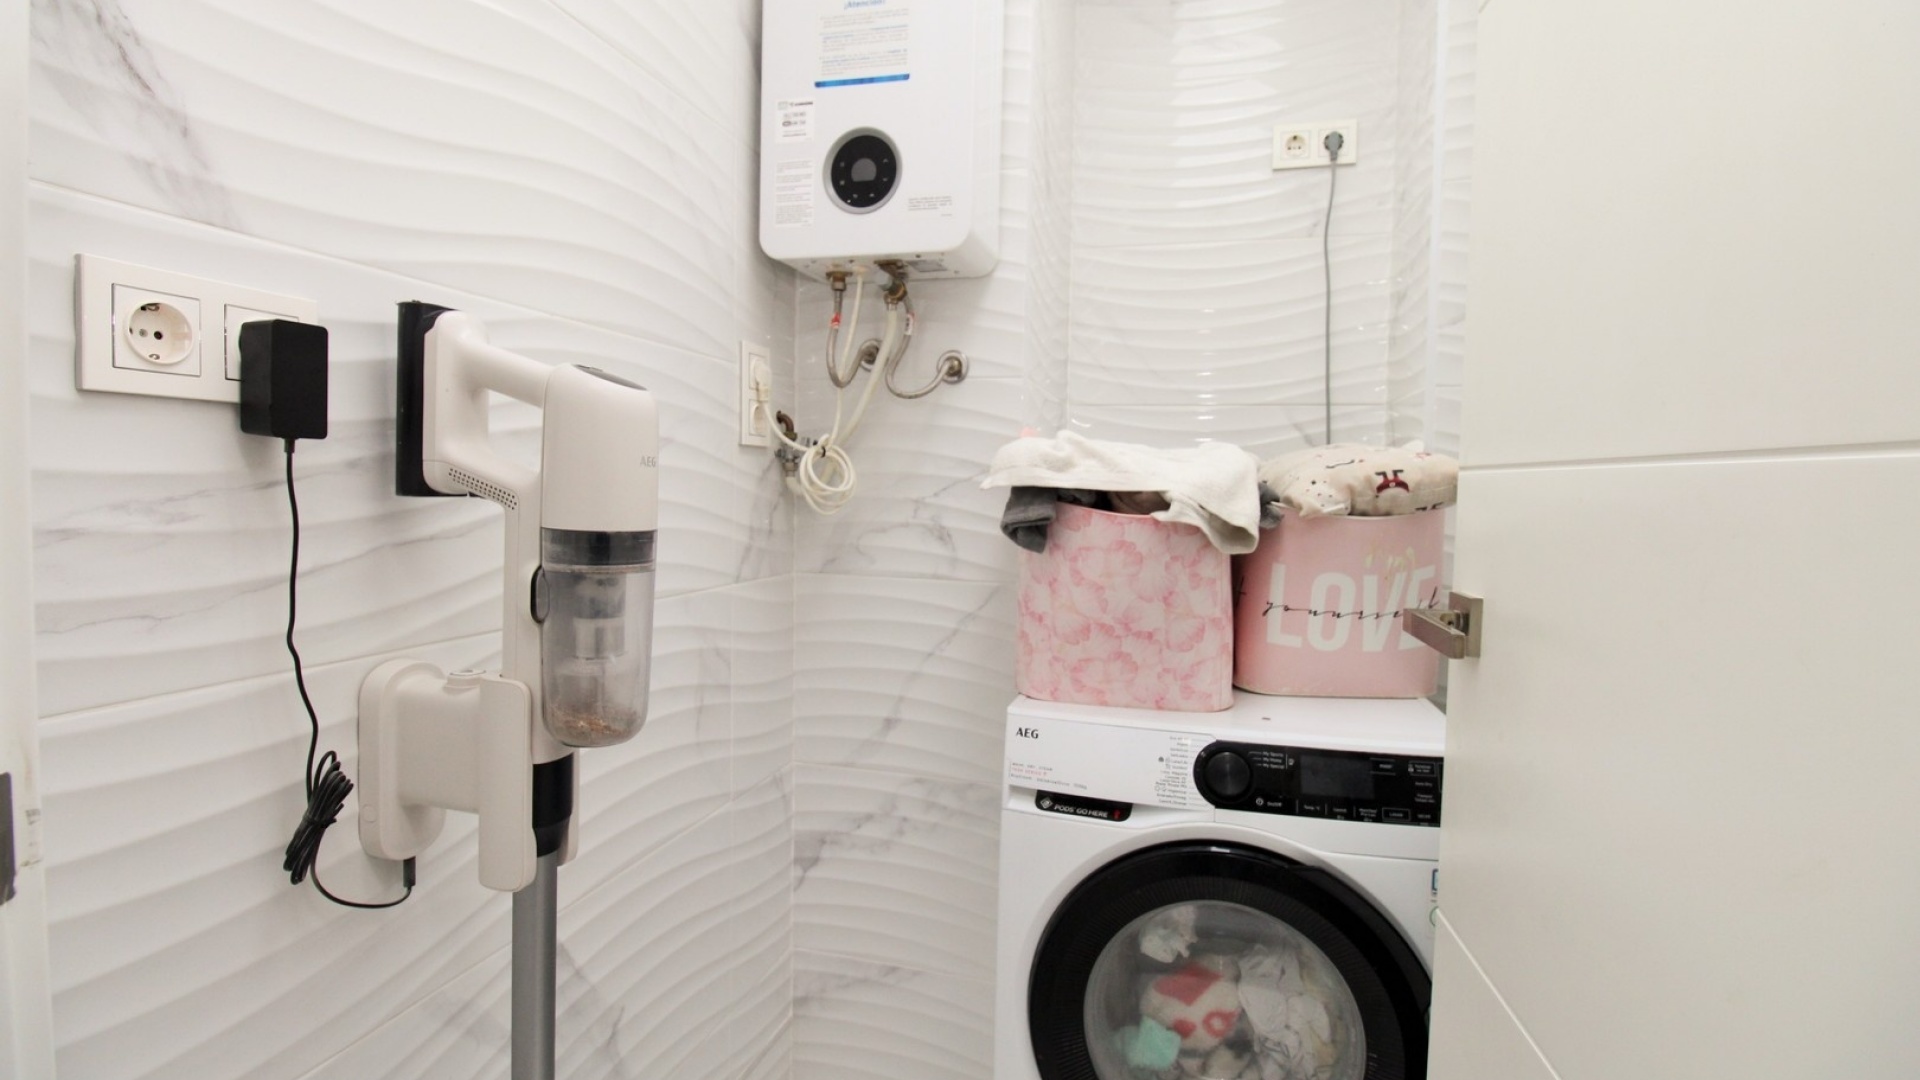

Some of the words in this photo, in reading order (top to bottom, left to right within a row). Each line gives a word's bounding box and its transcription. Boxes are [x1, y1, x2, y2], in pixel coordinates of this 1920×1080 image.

[640, 455, 657, 468] AEG
[1266, 562, 1436, 653] LOVE
[1016, 727, 1039, 739] AEG
[1088, 810, 1108, 818] HERE
